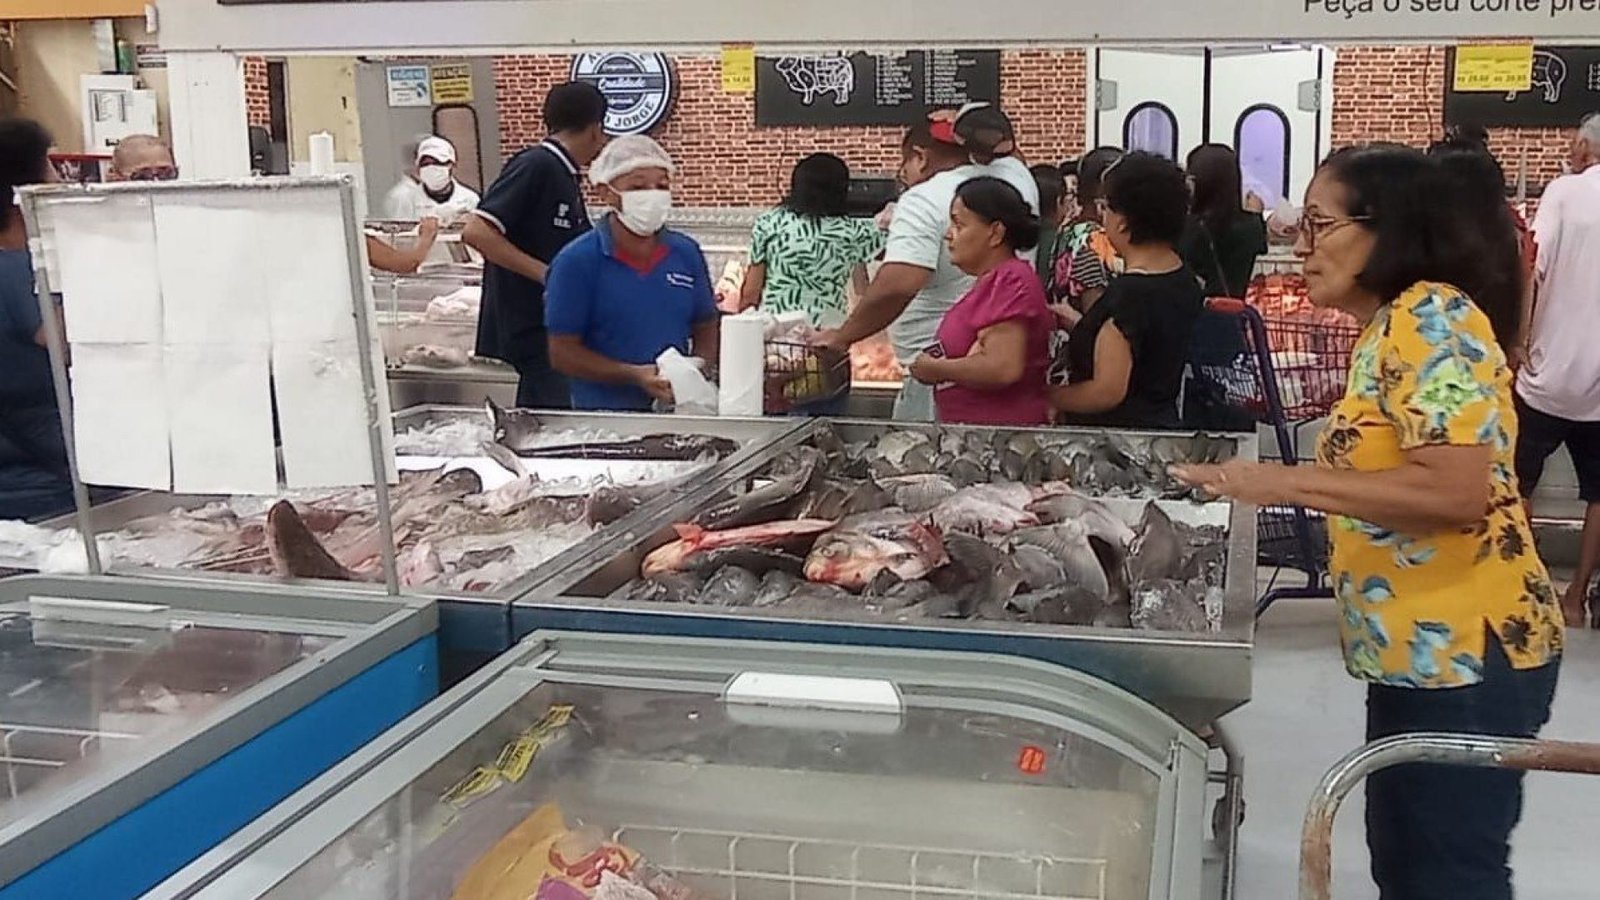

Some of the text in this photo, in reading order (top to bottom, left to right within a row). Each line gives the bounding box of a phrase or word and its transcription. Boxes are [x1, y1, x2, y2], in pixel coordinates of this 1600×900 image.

[1304, 0, 1600, 20] Peça o seu corte pre
[613, 101, 655, 128] JORGE
